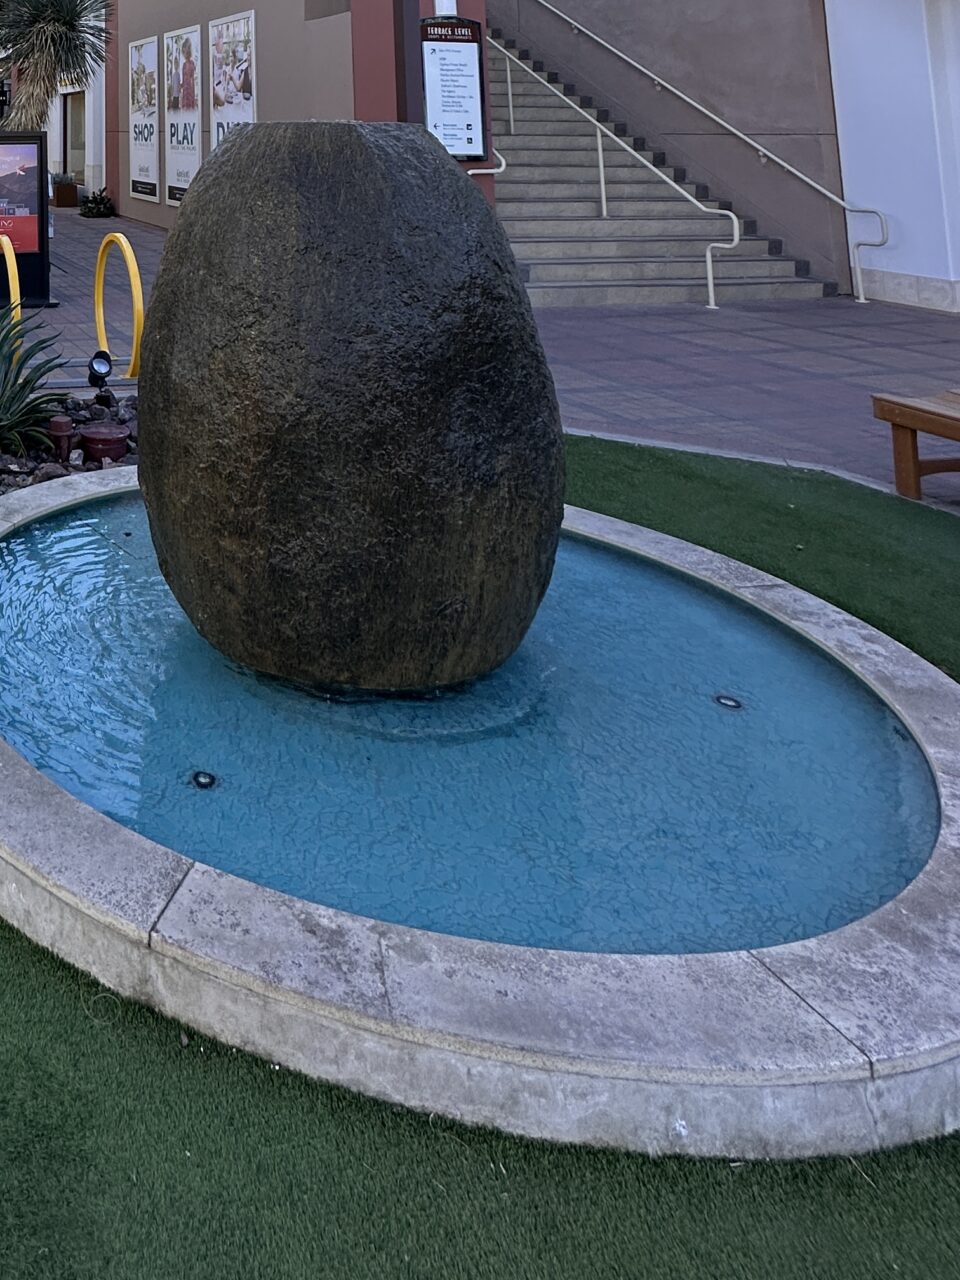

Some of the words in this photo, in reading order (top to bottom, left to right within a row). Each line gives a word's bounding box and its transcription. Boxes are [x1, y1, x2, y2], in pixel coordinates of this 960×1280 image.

[427, 26, 452, 35] TERRACE
[454, 27, 472, 36] LEVEL
[133, 123, 155, 143] SHOP
[169, 122, 196, 146] PLAY
